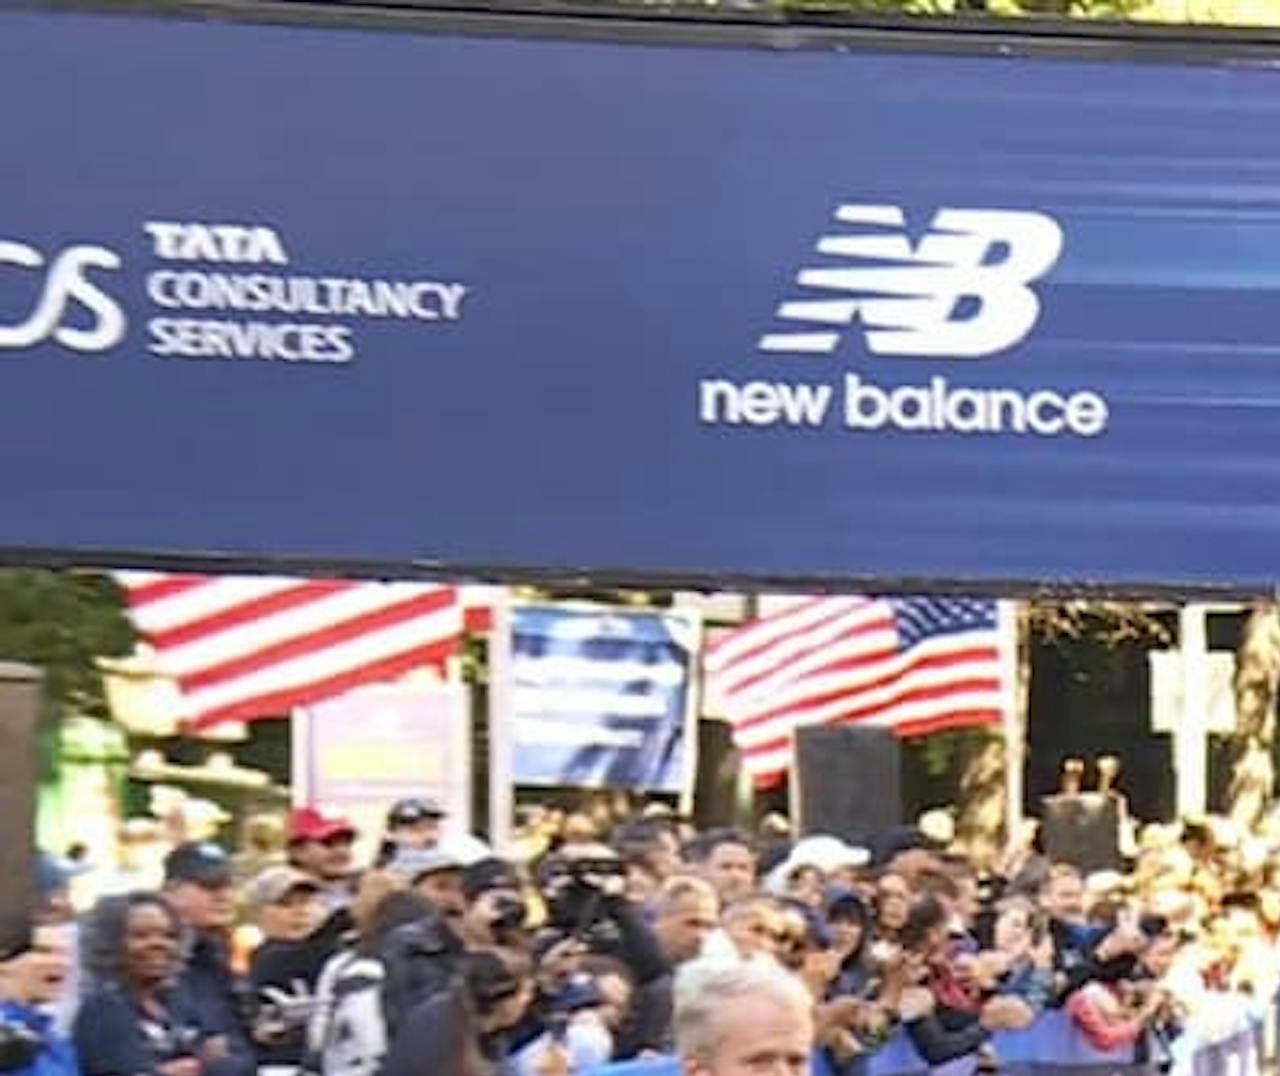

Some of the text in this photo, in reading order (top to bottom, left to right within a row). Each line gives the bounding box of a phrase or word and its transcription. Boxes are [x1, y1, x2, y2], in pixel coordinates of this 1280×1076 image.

[144, 222, 287, 263] TATA
[147, 270, 466, 320] CONSULTANCY
[760, 204, 1064, 357] NB
[148, 317, 354, 362] SERVICES
[701, 373, 1108, 435] new balance
